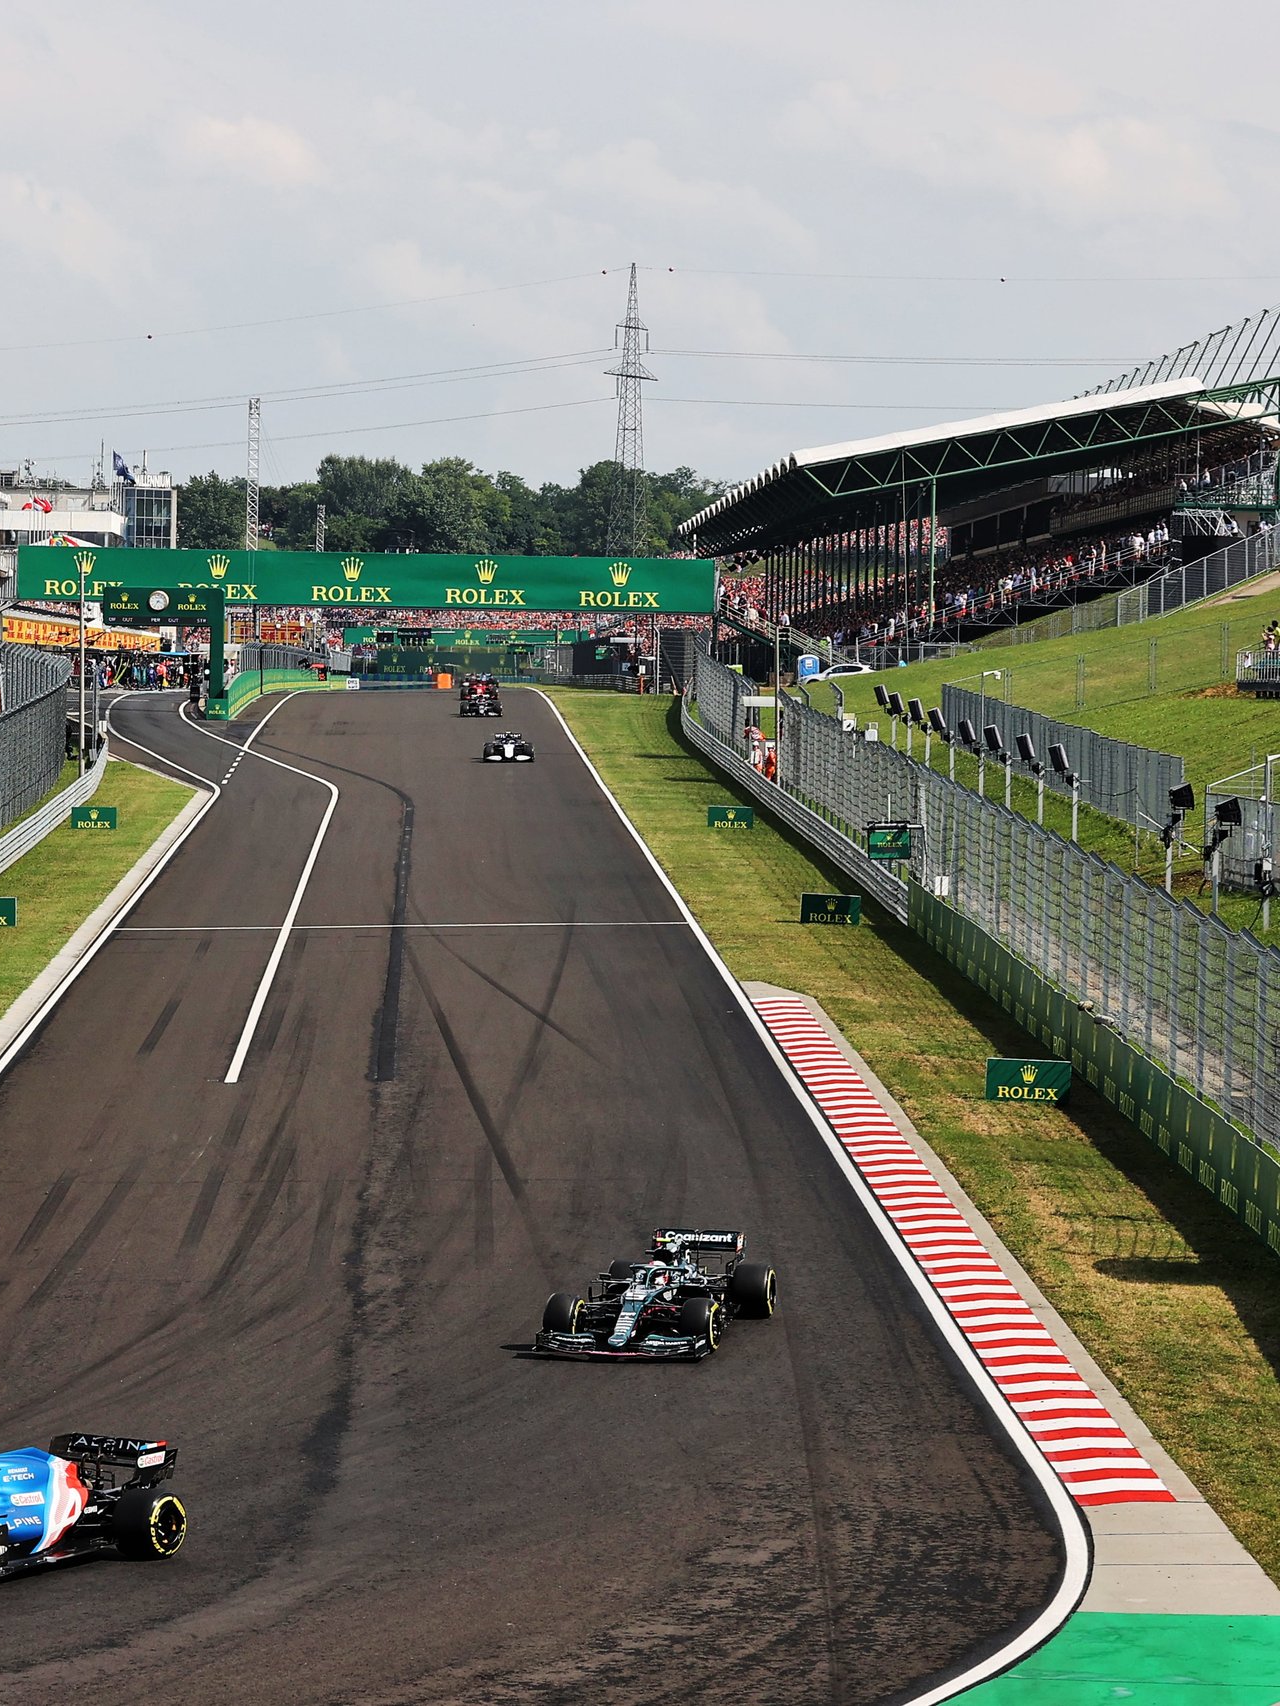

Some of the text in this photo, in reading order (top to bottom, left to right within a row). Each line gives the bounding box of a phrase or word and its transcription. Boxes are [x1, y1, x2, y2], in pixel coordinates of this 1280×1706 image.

[311, 586, 392, 603] ROLEX
[445, 588, 526, 605] ROLEX
[579, 590, 660, 608] ROLEX
[110, 602, 139, 610] ROLEX
[383, 665, 406, 673] ROLEX
[77, 821, 111, 829] ROLEX
[713, 820, 747, 829] ROLEX
[809, 912, 852, 924] ROLEX
[997, 1085, 1059, 1101] ROLEX
[2, 1472, 35, 1482] E-TECH
[18, 1493, 42, 1504] Castrol
[0, 1515, 42, 1531] LPINE
